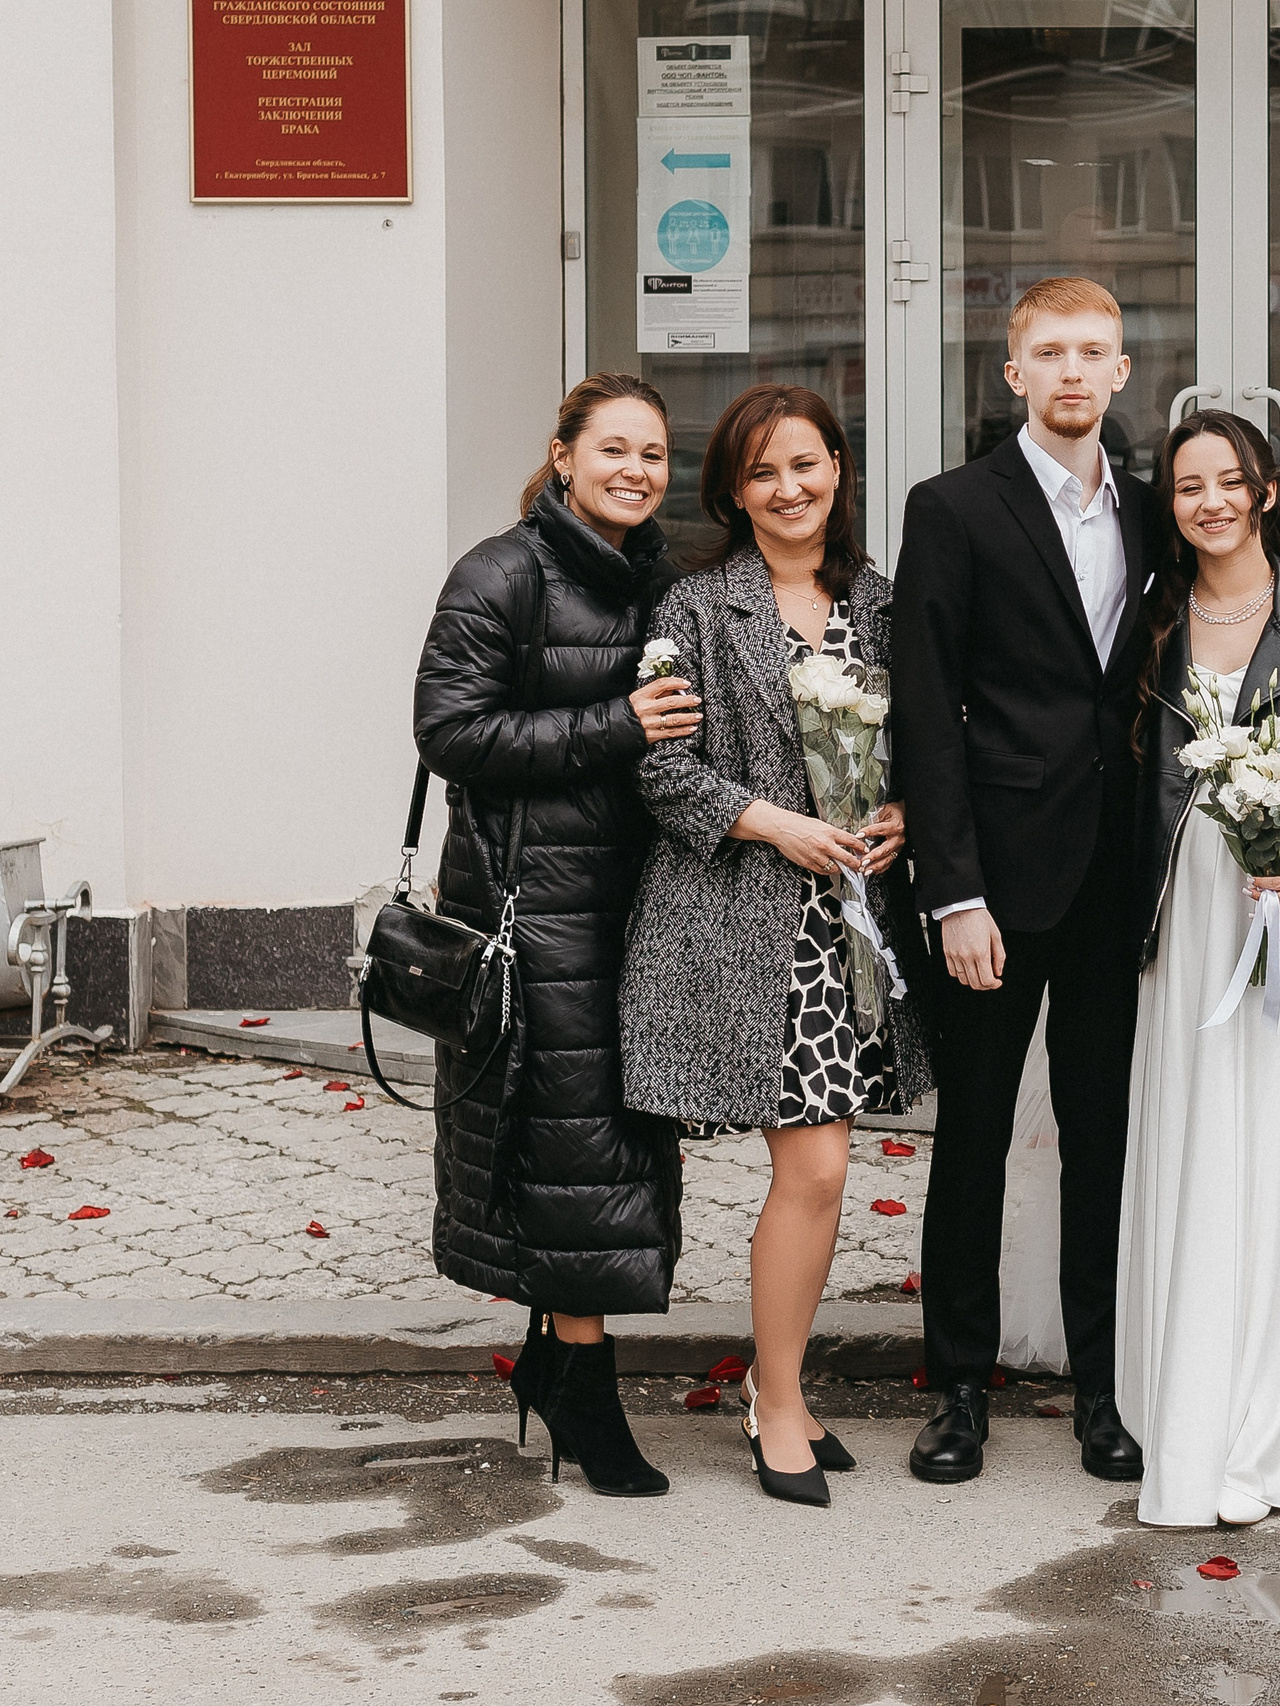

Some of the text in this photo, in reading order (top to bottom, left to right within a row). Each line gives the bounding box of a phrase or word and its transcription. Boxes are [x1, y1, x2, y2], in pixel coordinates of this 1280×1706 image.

[213, 1, 385, 11] ГРАЖДАНСКОГО СОСТОЯНИЯ
[222, 12, 376, 25] СВЕРДЛОВСКОЙ ОБЛАСТИ
[288, 42, 311, 52] ЗАЛ
[245, 56, 353, 66] ТОРЖЕСТВЕННЫХ
[262, 67, 337, 80] ЦЕРЕМОНИЙ
[258, 97, 342, 107] РЕГИСТРАЦИЯ
[258, 110, 343, 121] ЗАКЛЮЧЕНИЯ
[281, 124, 320, 134] БРАКА
